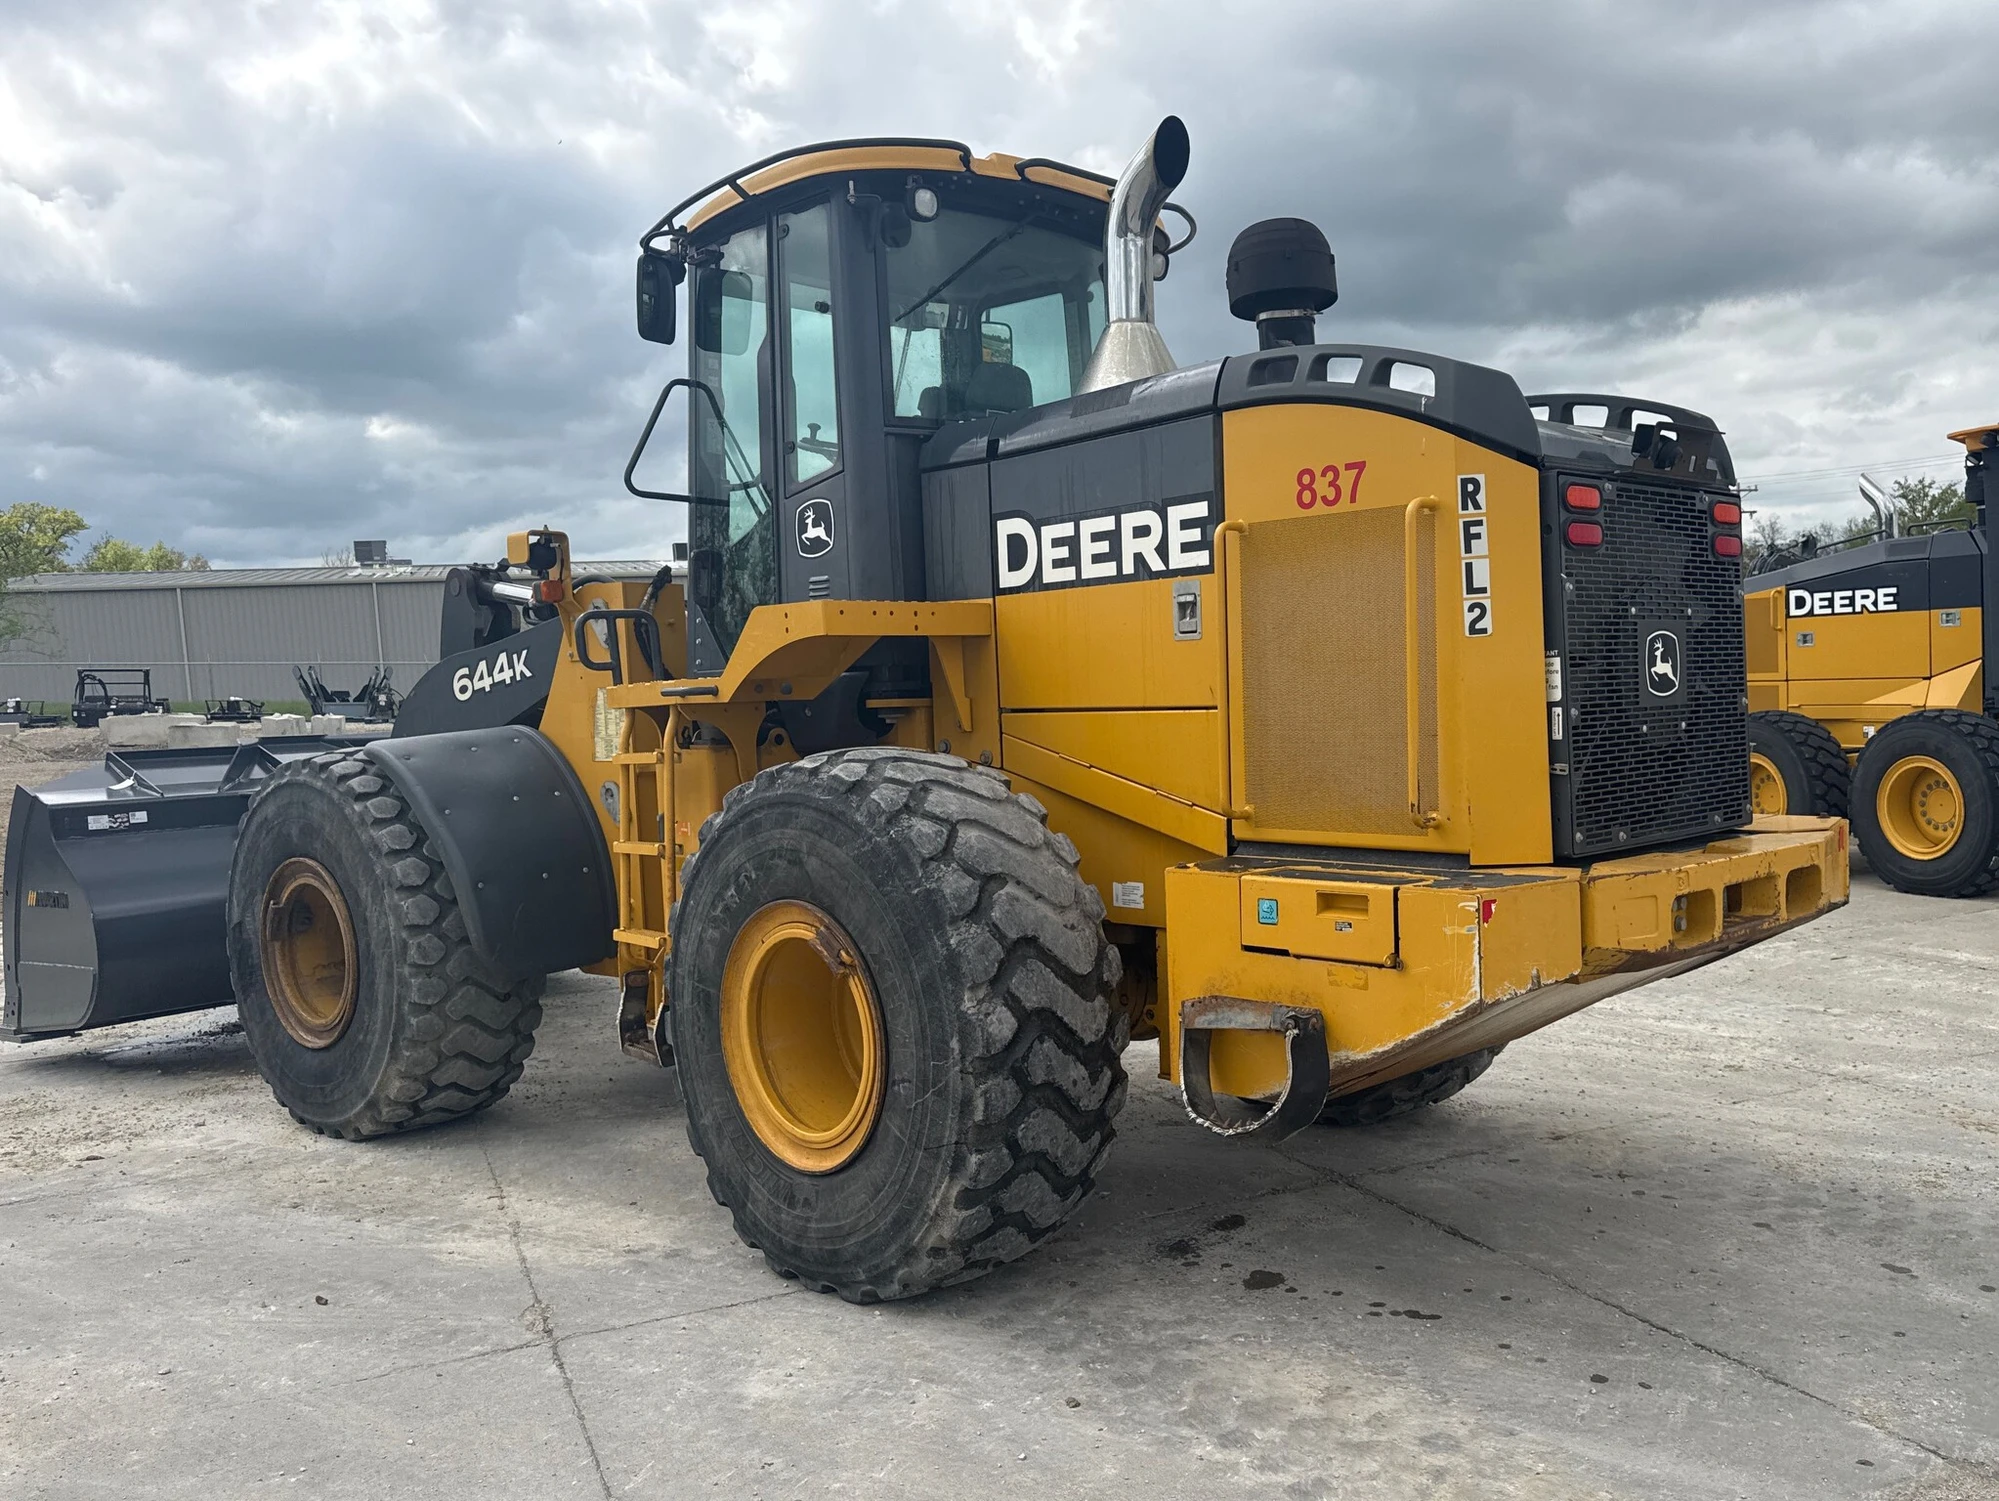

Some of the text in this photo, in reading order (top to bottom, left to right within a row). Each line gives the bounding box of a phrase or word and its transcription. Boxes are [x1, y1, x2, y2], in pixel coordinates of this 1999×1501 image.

[1296, 460, 1367, 510] 837
[996, 500, 1210, 589] DEERE
[1788, 586, 1898, 617] DEERE
[452, 648, 533, 701] 644K
